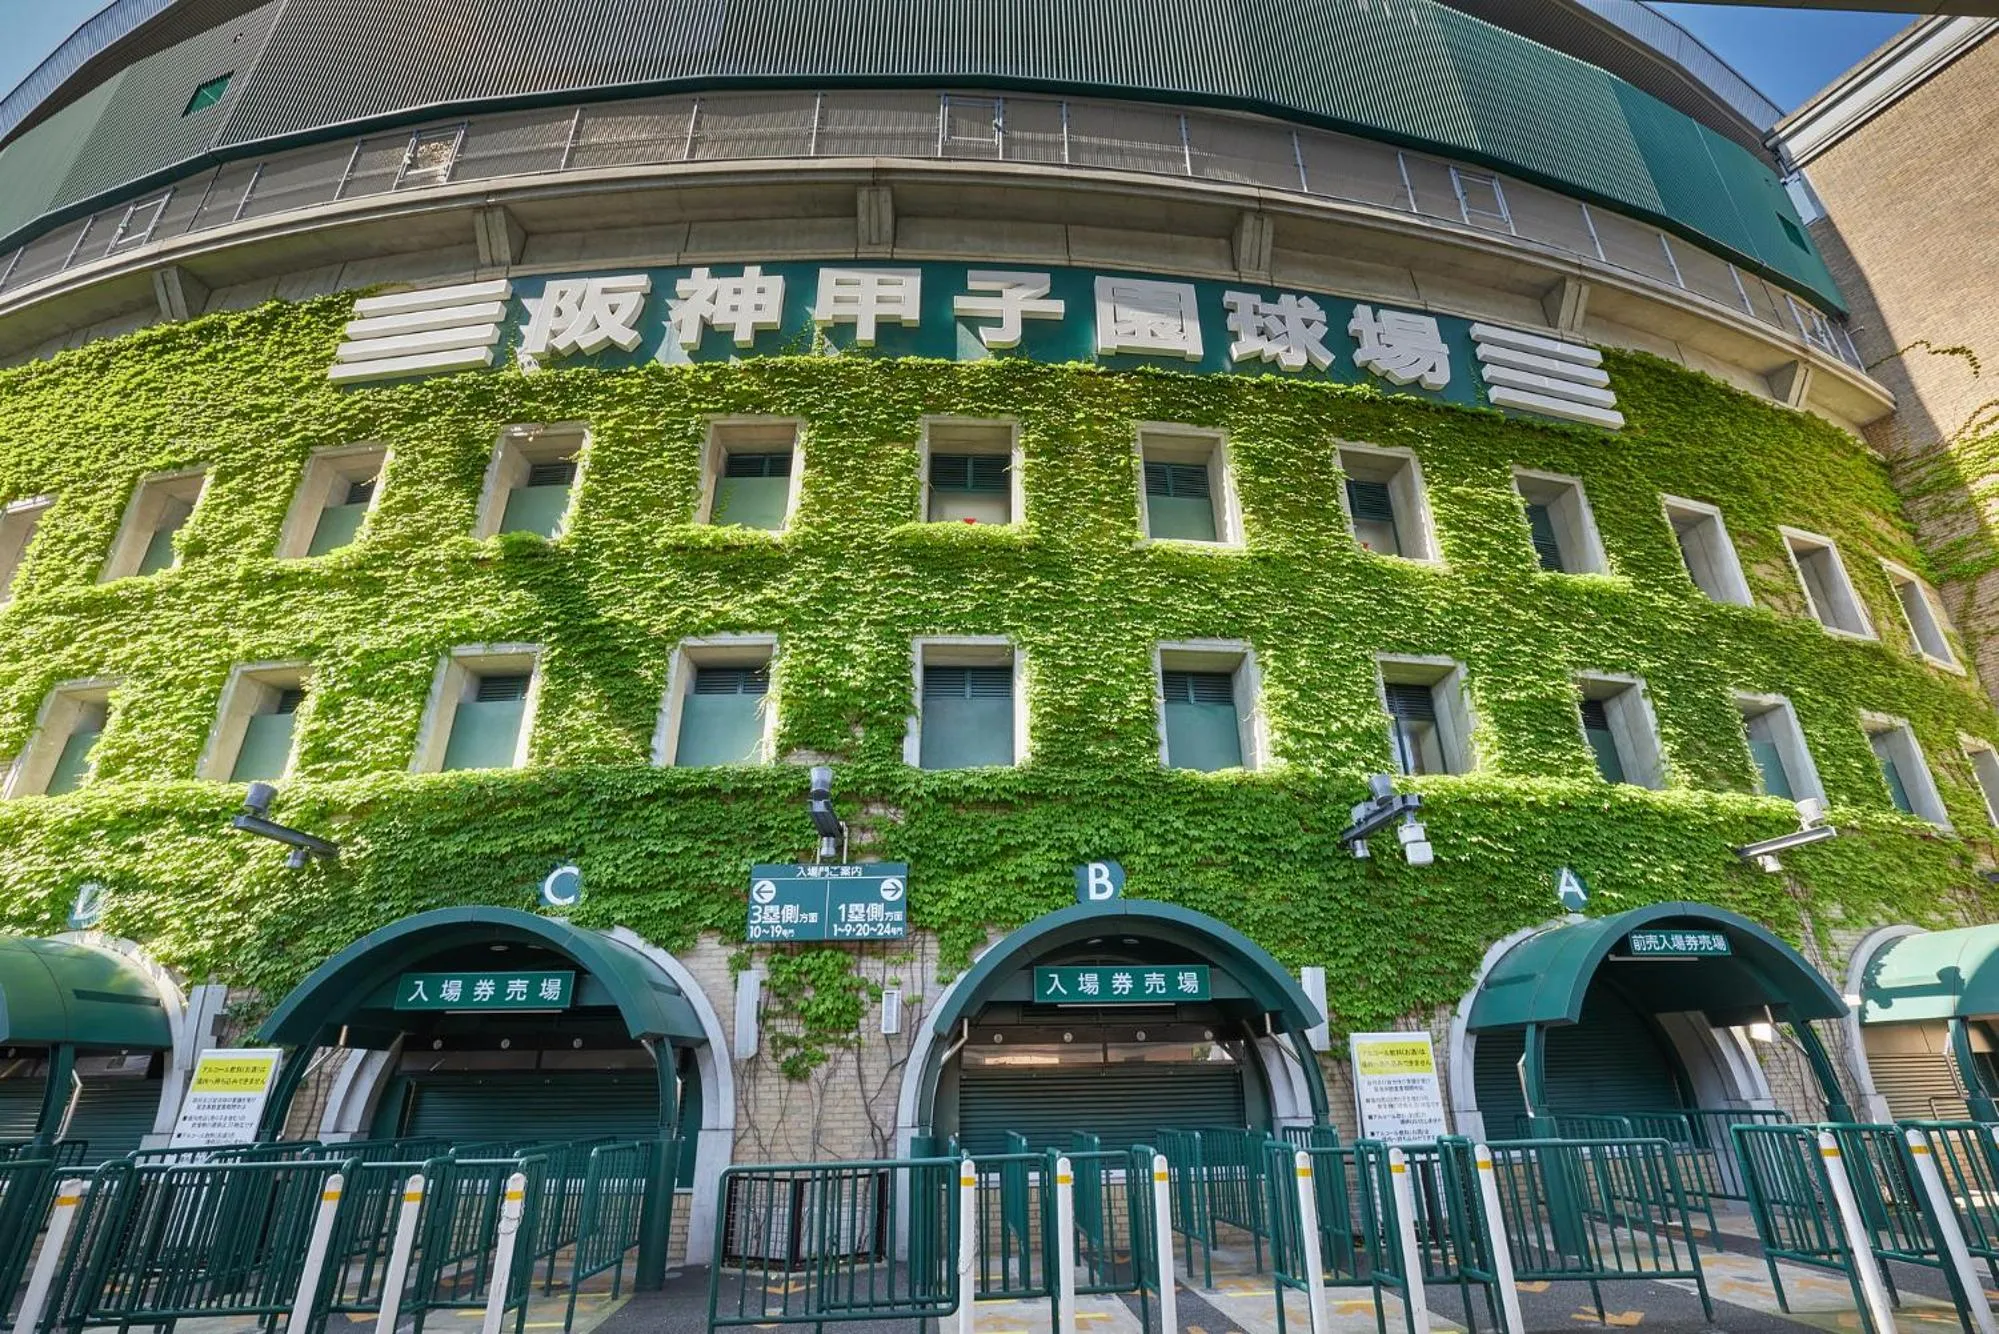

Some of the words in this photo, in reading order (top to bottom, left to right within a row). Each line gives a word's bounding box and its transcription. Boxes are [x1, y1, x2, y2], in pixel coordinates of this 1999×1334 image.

[522, 265, 1451, 390] 阪神甲子園球場
[543, 865, 580, 905] C
[796, 866, 862, 877] 入場門ご案内
[1087, 862, 1114, 900] B
[1556, 866, 1588, 902] A
[1631, 934, 1728, 951] 前売入場券売場
[407, 978, 562, 1002] 入場券売場
[1046, 972, 1199, 995] 入場券売場
